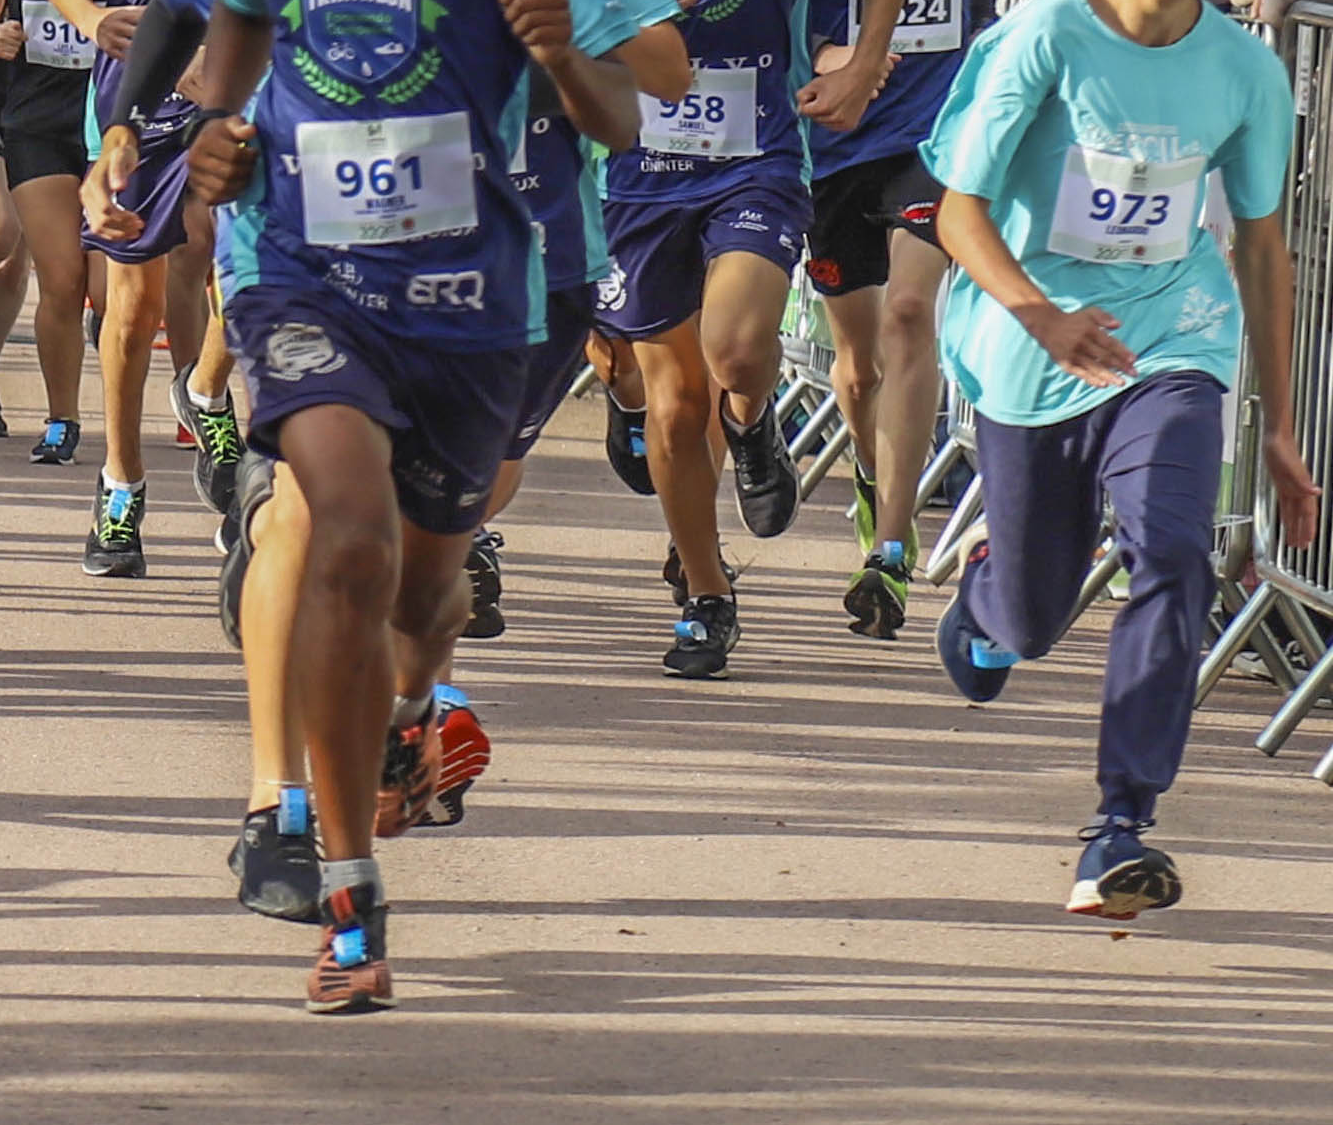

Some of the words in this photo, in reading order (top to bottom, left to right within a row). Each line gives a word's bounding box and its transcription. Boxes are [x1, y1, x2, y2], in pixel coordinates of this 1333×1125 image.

[658, 94, 725, 123] 958
[334, 155, 423, 199] 961
[1088, 187, 1171, 226] 973
